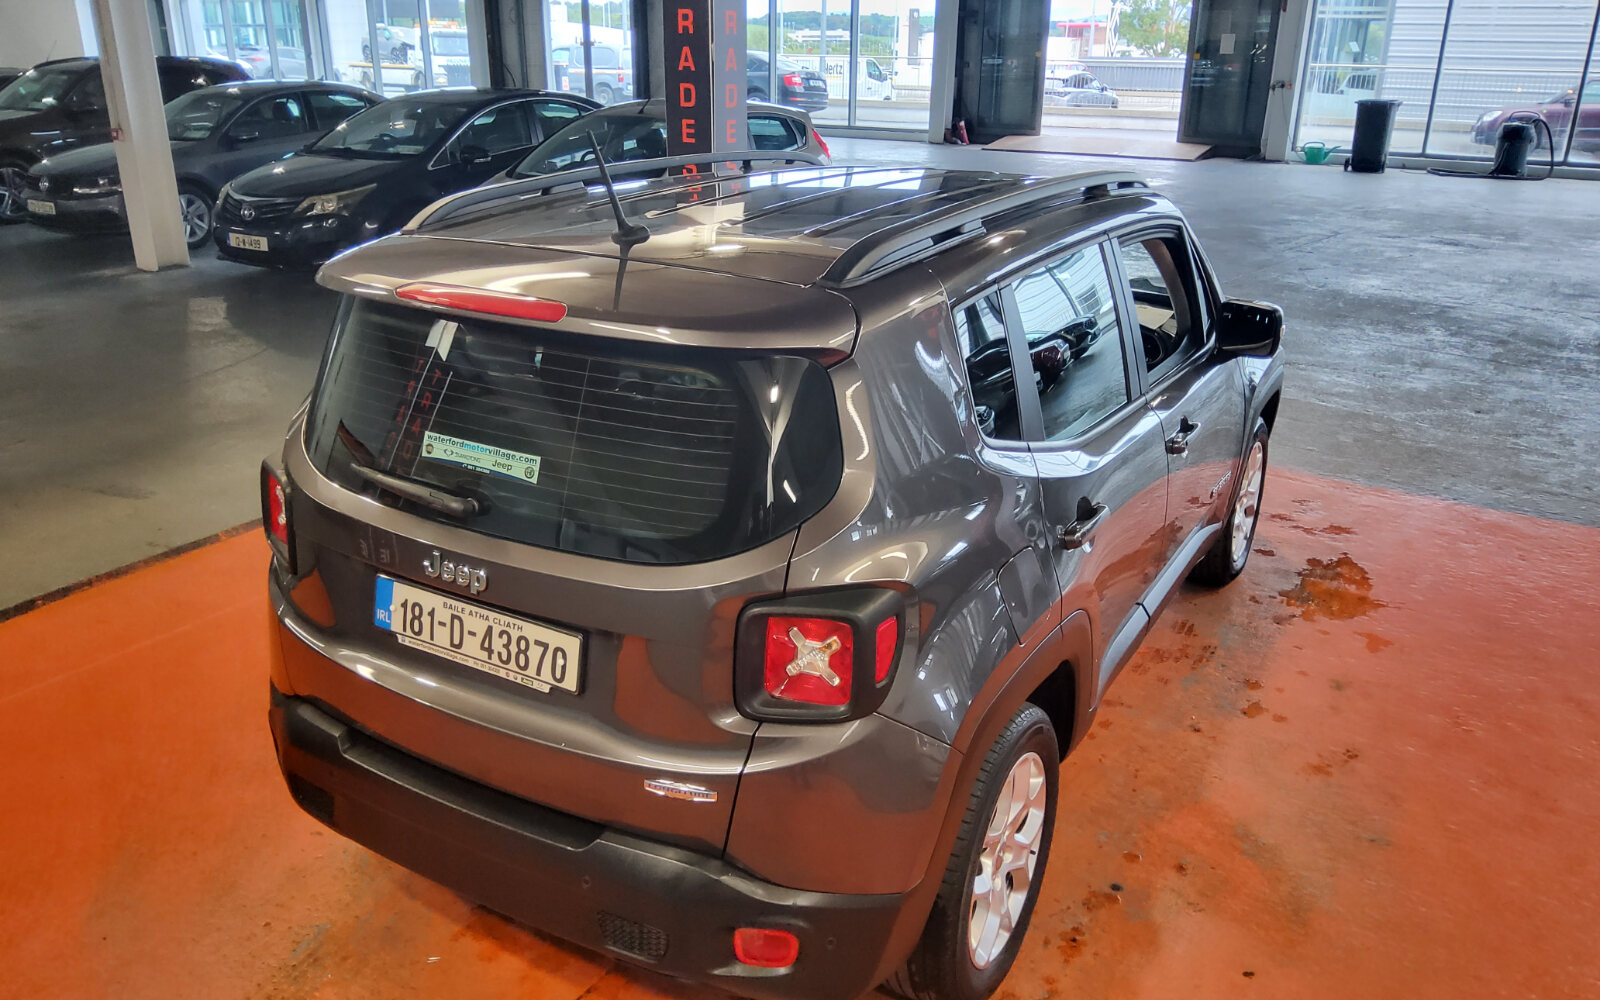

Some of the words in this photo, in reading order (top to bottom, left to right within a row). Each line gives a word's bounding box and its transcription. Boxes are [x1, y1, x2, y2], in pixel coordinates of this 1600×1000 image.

[427, 433, 537, 465] waterfordmotorvillage.com
[491, 459, 513, 471] Jeep
[423, 550, 488, 595] Jeep
[376, 608, 391, 624] IRL
[443, 601, 466, 615] BAILE
[468, 609, 490, 622] ATHA
[492, 617, 523, 633] CLIATH
[400, 598, 568, 684] 181-D-43870
